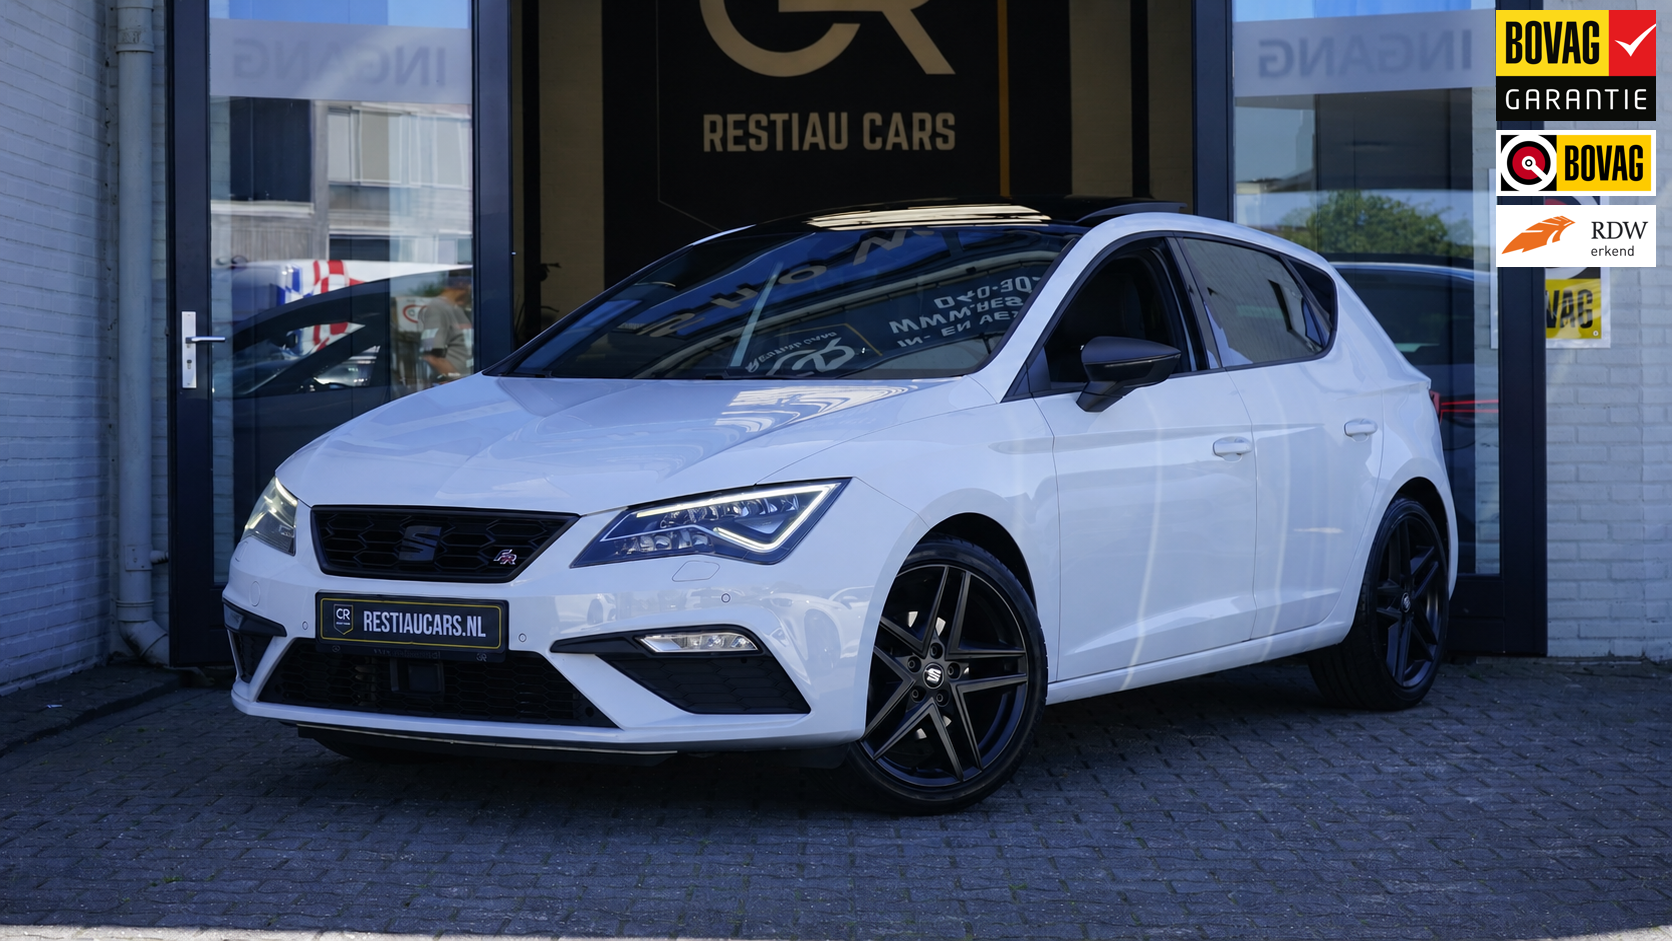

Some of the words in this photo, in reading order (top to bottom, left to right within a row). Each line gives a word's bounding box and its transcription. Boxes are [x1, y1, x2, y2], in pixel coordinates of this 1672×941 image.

[703, 112, 848, 152] RESTIAU
[863, 112, 956, 151] CARS
[336, 608, 350, 620] CR
[364, 611, 486, 637] RESTIAUCARS.NL
